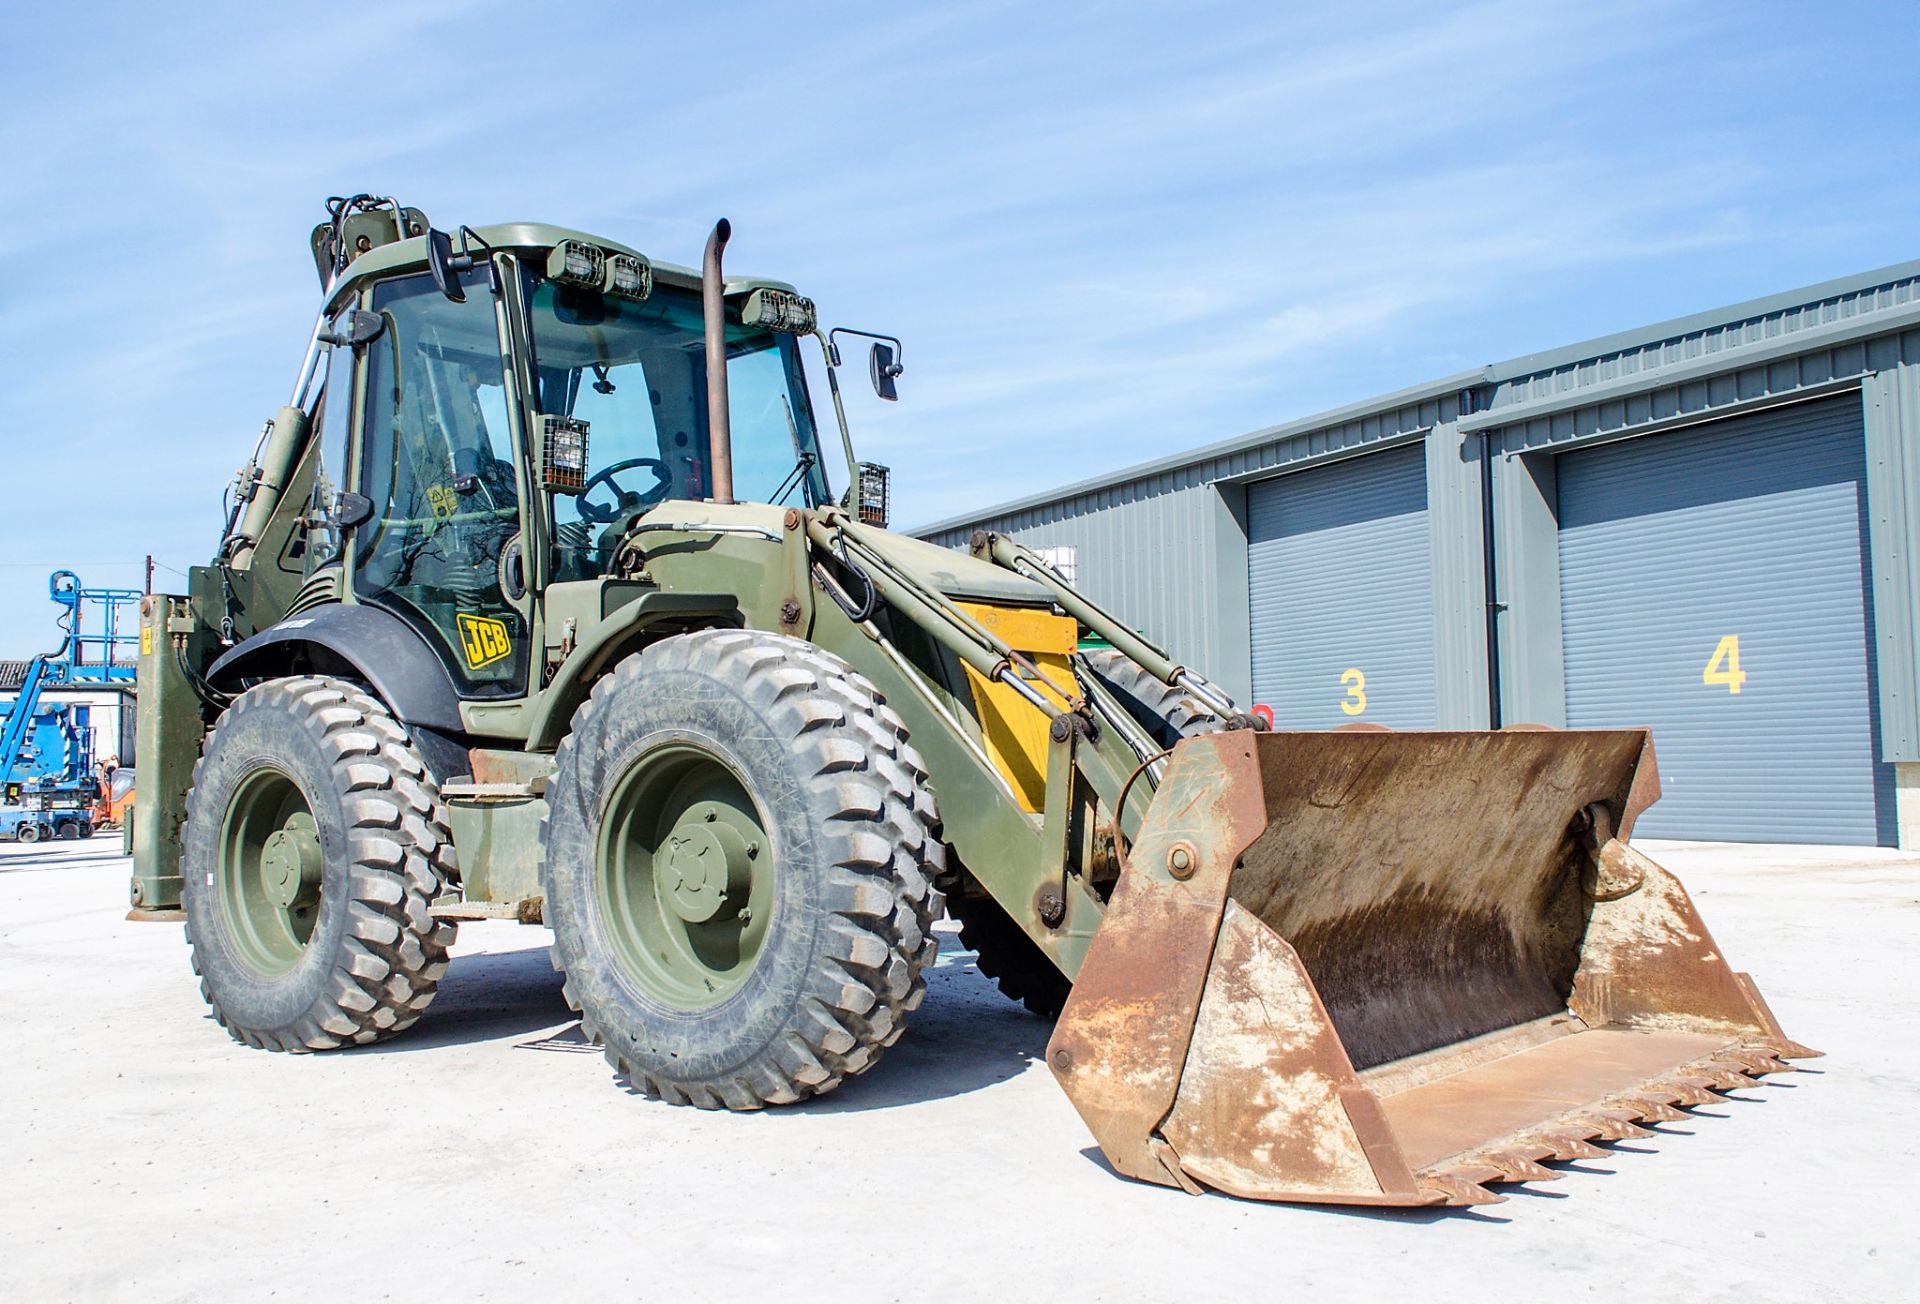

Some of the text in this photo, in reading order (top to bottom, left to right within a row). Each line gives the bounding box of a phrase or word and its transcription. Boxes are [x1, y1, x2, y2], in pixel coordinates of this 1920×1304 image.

[465, 618, 509, 664] JCB
[1703, 634, 1746, 695] 4
[1340, 668, 1367, 716] 3
